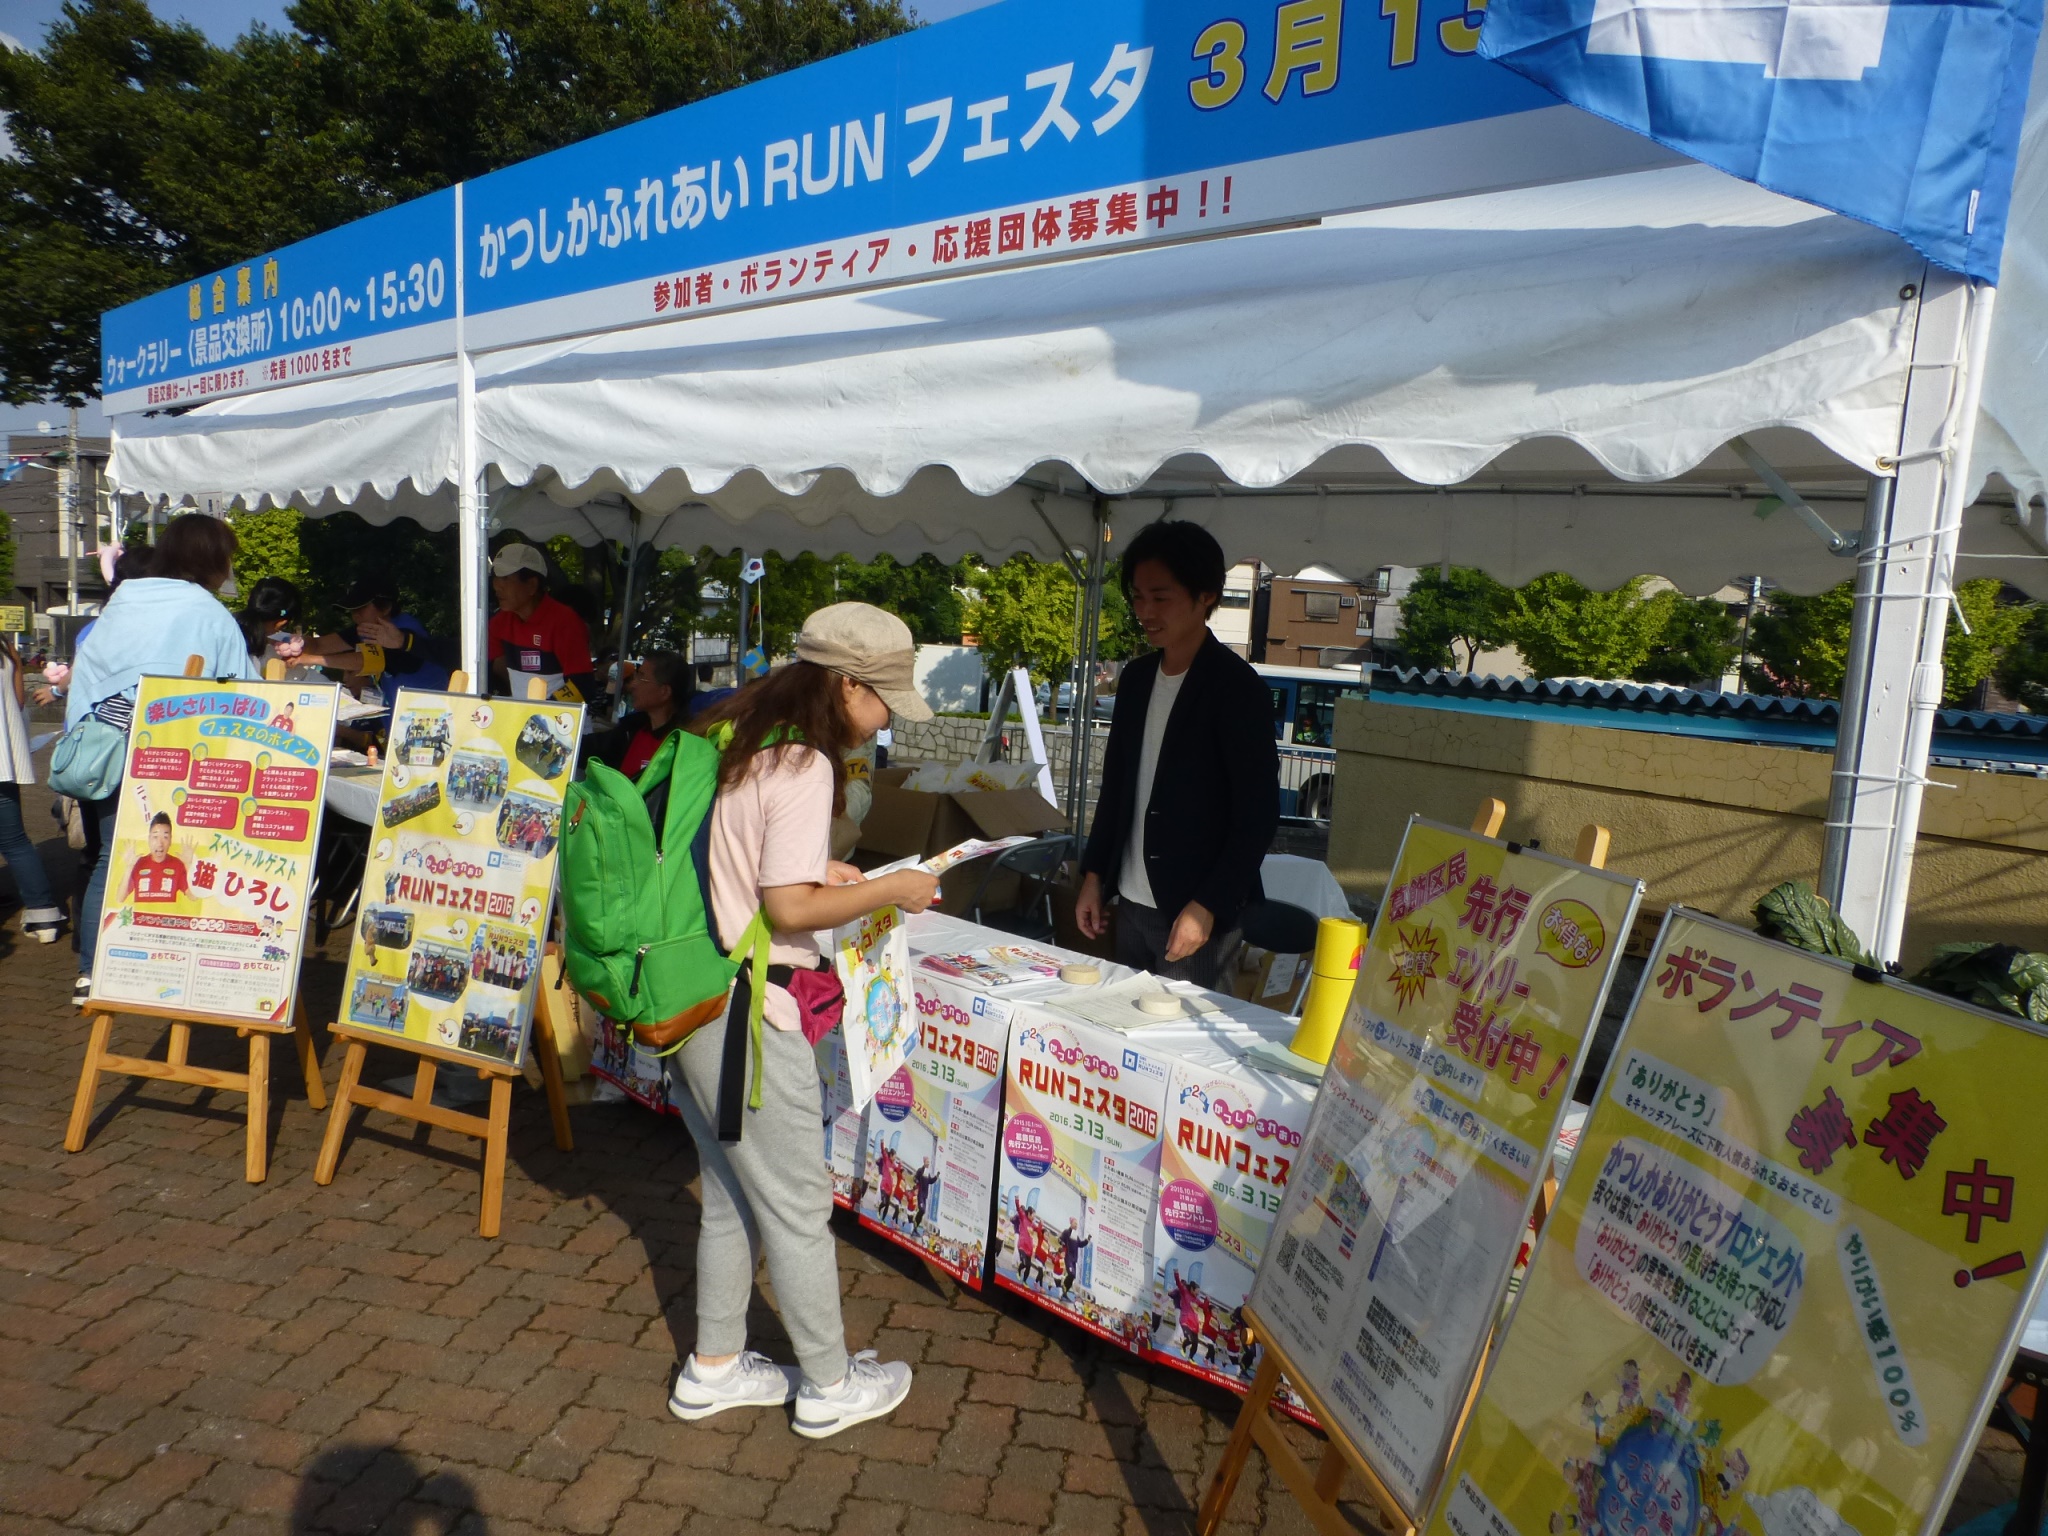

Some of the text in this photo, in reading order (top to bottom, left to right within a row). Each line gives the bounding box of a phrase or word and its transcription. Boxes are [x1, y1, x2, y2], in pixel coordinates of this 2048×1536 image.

[147, 697, 267, 723] 楽しさいっぱい
[204, 721, 317, 761] フェスタのポイント
[209, 832, 297, 880] スペシャルゲスト
[1457, 875, 1532, 948] 先行
[1446, 946, 1531, 1006] エントリー
[1656, 945, 1922, 1077] ボランティア
